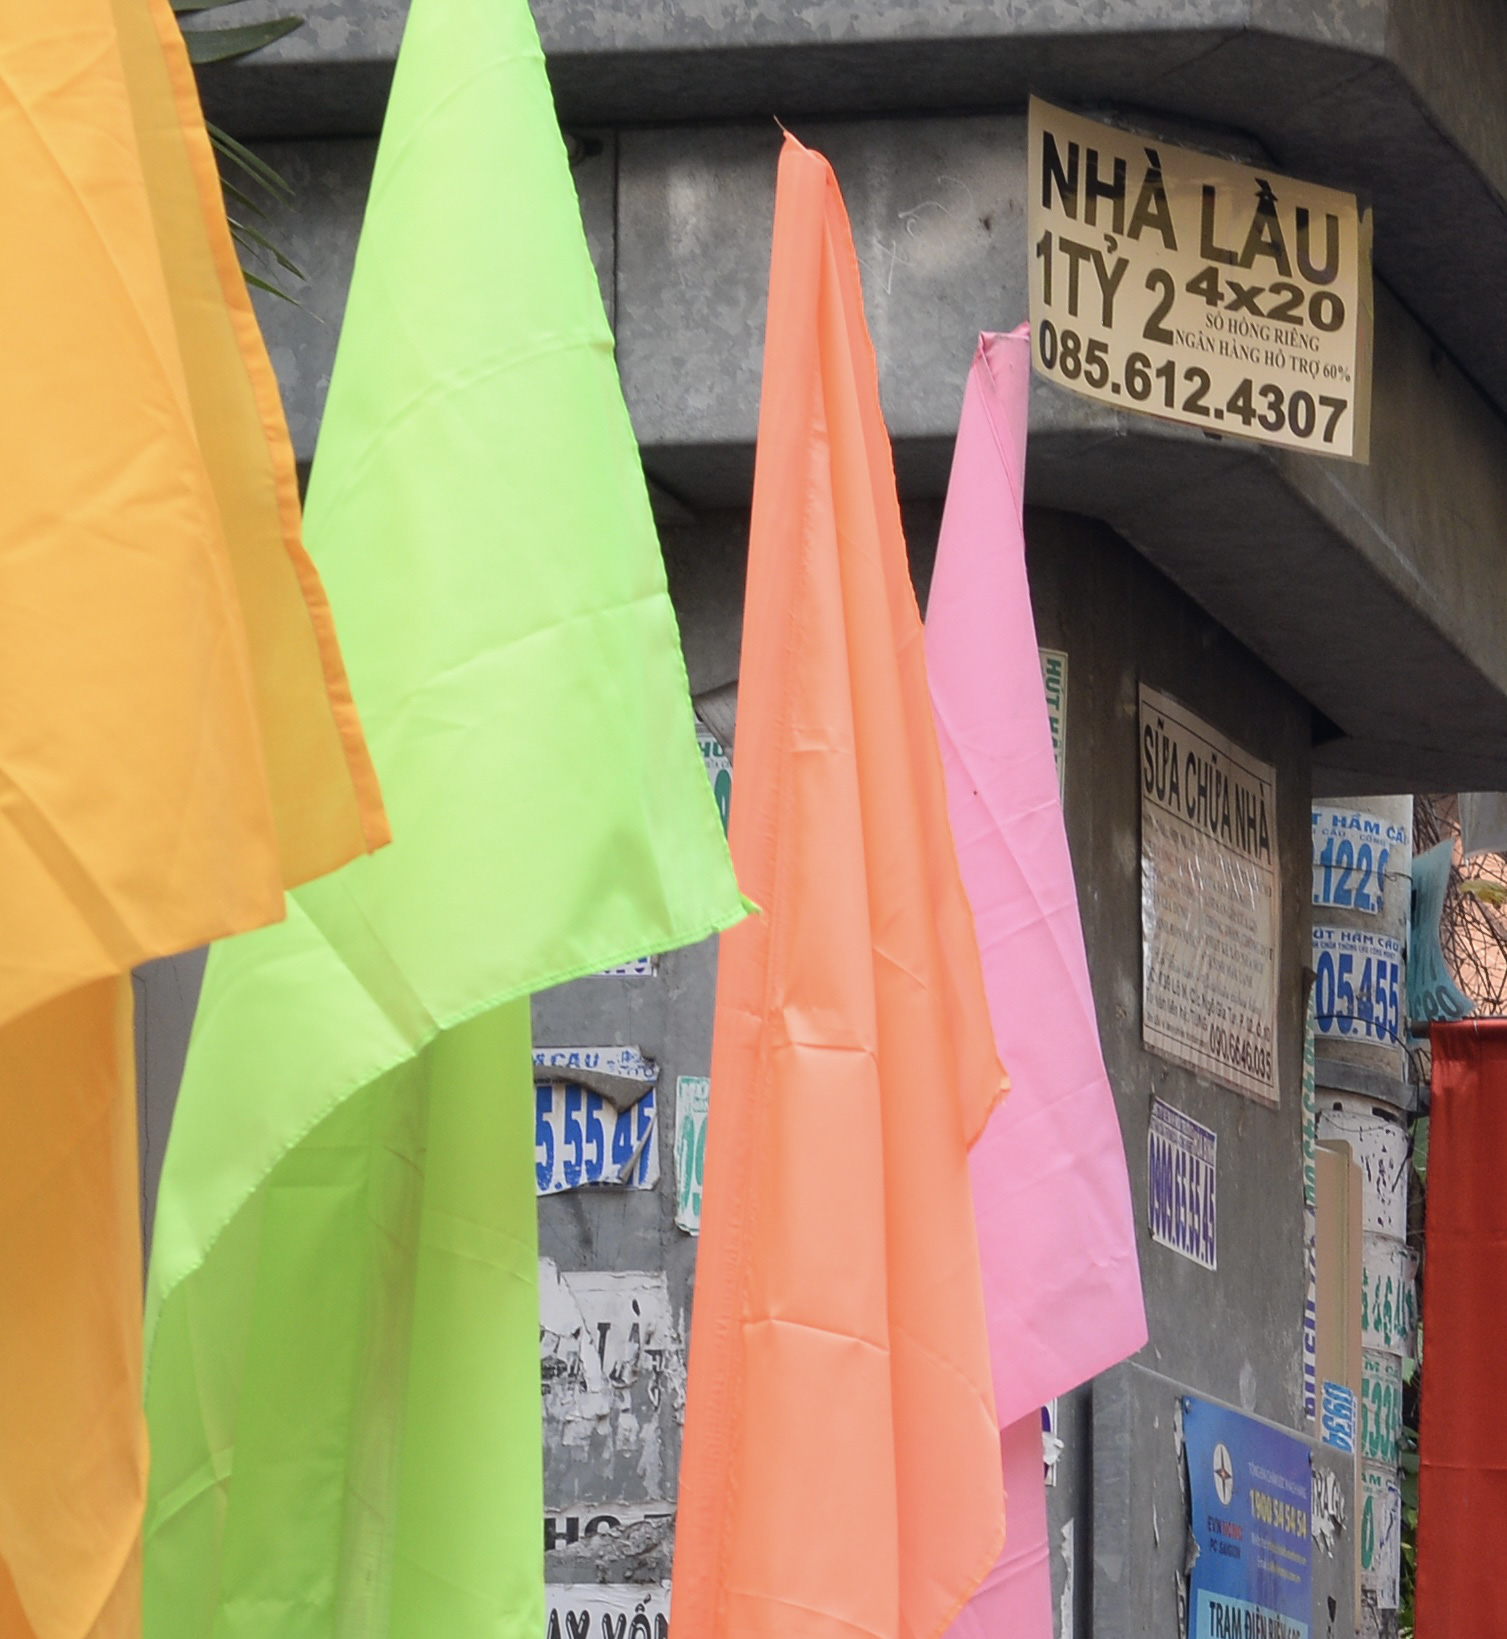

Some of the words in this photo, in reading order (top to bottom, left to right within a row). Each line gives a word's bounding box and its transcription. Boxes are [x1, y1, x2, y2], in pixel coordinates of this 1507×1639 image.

[1042, 130, 1178, 252] NHÀ
[1200, 178, 1339, 286] LẦU
[1142, 267, 1177, 345] 2
[1274, 328, 1320, 352] RIÊNG
[1039, 319, 1348, 443] 085.612.4307
[1323, 362, 1351, 382] 60%
[1235, 782, 1271, 866] NHÀ
